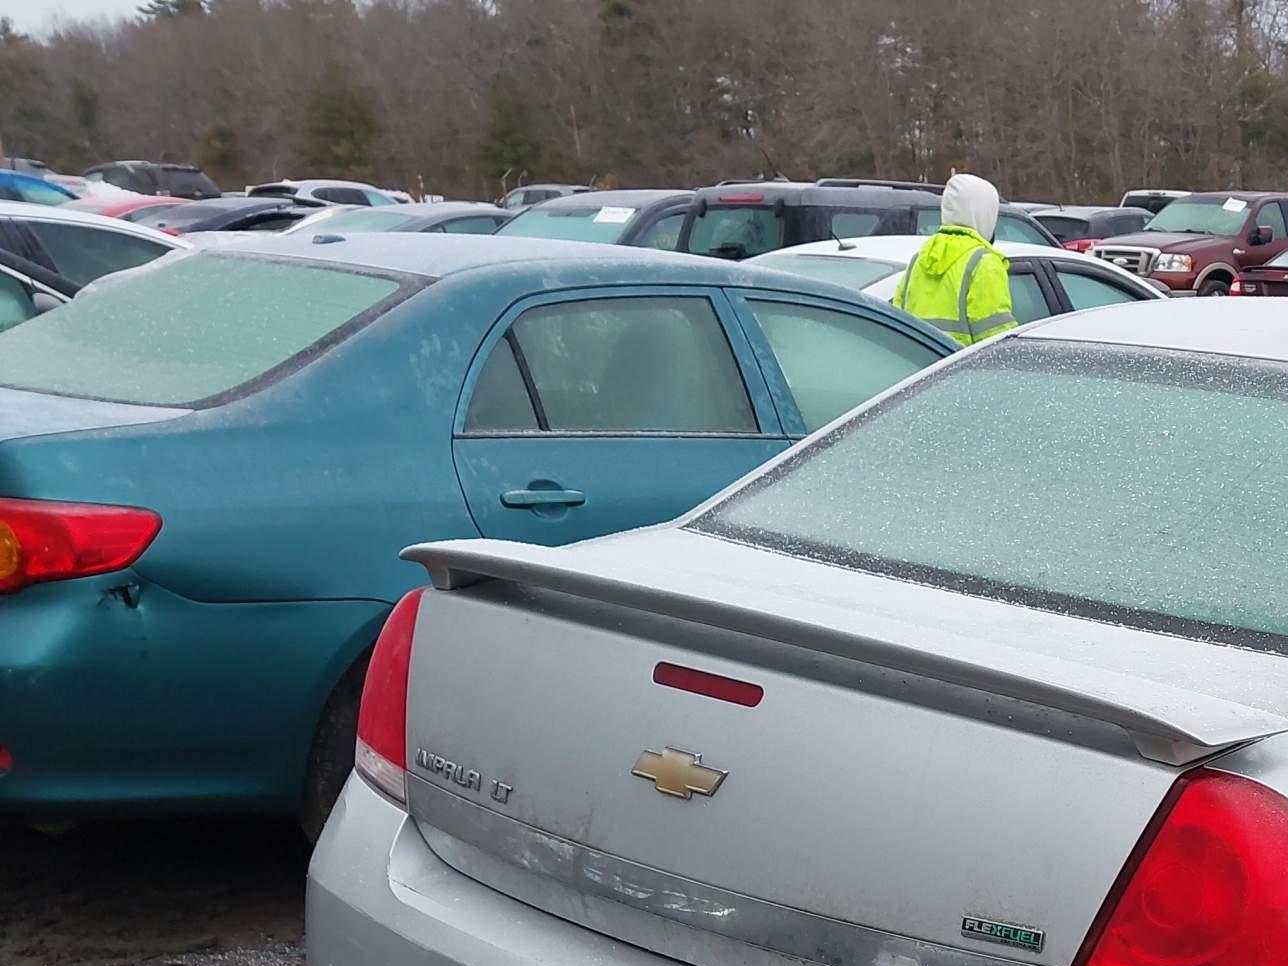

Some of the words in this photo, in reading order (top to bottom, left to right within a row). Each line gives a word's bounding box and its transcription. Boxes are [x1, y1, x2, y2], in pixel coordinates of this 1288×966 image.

[415, 747, 482, 792] IMPALA
[490, 779, 514, 805] LT
[964, 918, 1039, 945] FLEXFUEL
